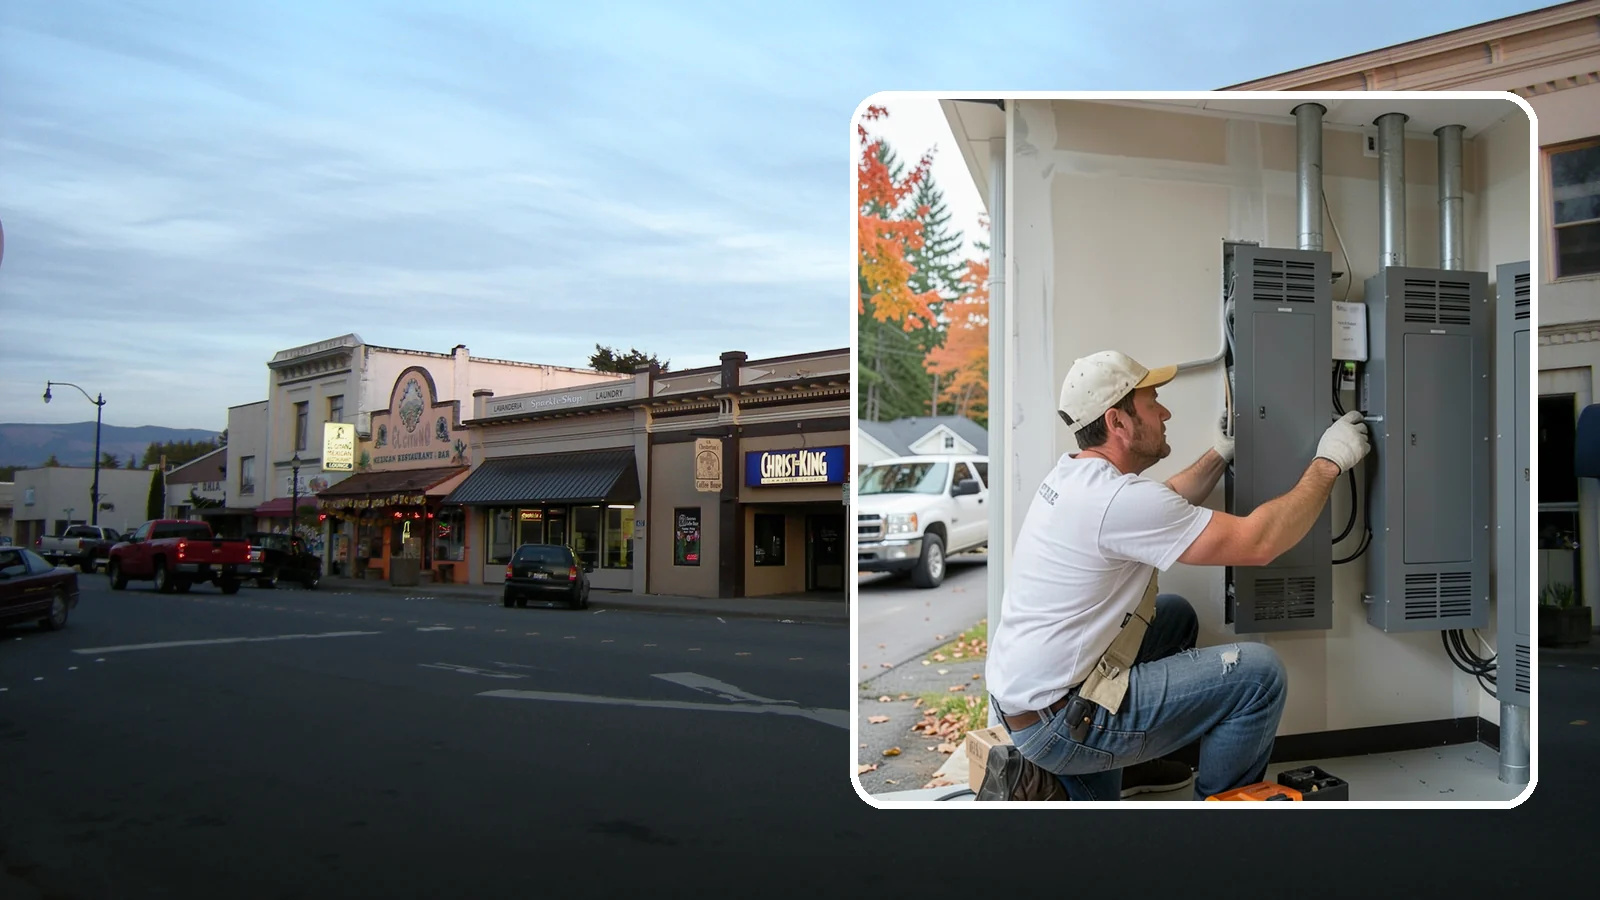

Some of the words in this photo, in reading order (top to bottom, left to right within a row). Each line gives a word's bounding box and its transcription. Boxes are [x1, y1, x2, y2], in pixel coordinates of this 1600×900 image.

[531, 398, 560, 409] Sparkle
[561, 394, 582, 407] Shop
[595, 389, 623, 400] LAUNDRY
[493, 402, 522, 412] LAVANDERIA
[374, 455, 395, 464] MEXICAN
[397, 452, 433, 462] RESTAURANT
[438, 449, 450, 459] BAR
[761, 452, 797, 477] CHRIST
[799, 450, 827, 476] KING
